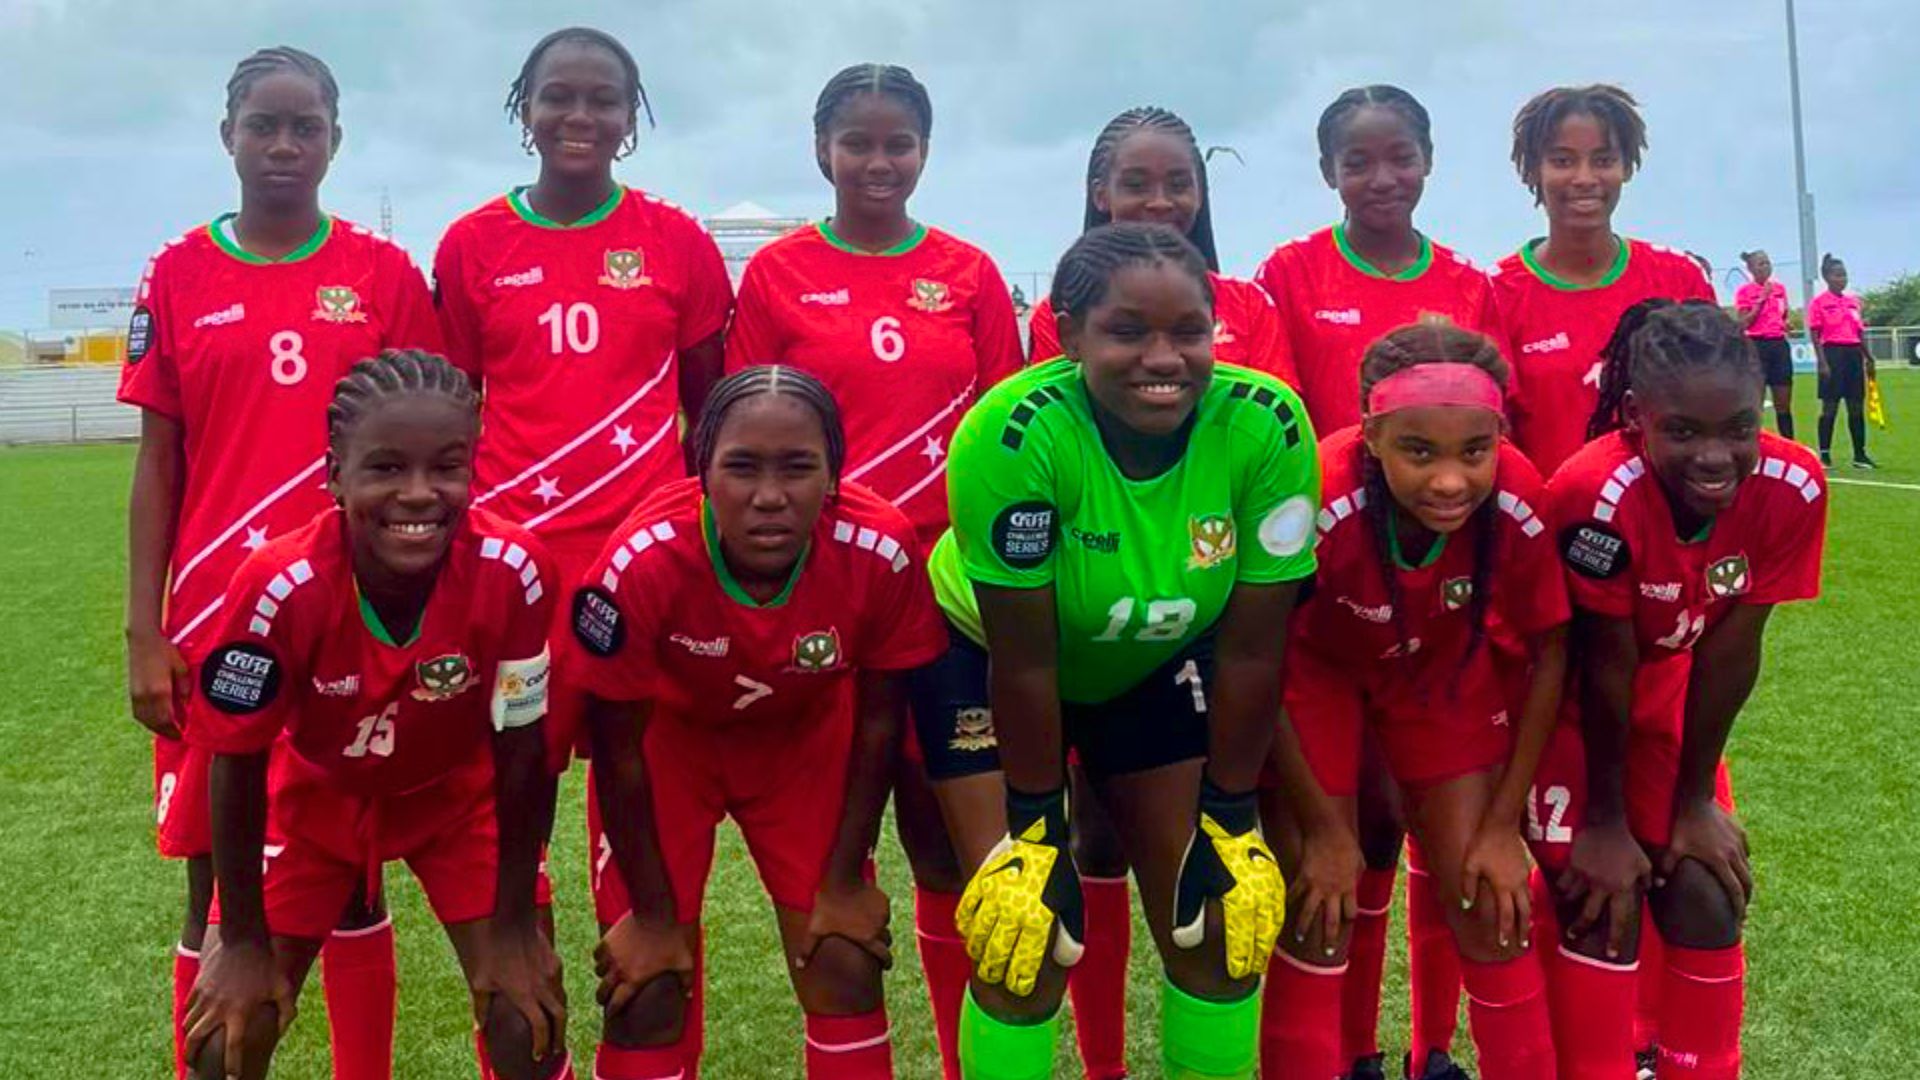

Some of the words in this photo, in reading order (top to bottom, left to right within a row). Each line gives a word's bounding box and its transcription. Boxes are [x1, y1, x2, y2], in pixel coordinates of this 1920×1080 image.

[538, 302, 600, 354] 10
[871, 316, 905, 362] 6
[269, 331, 307, 385] 8
[211, 677, 261, 700] SERIES
[733, 674, 773, 709] 7
[1174, 659, 1207, 713] 1
[342, 701, 399, 757] 15
[1528, 784, 1572, 843] 12
